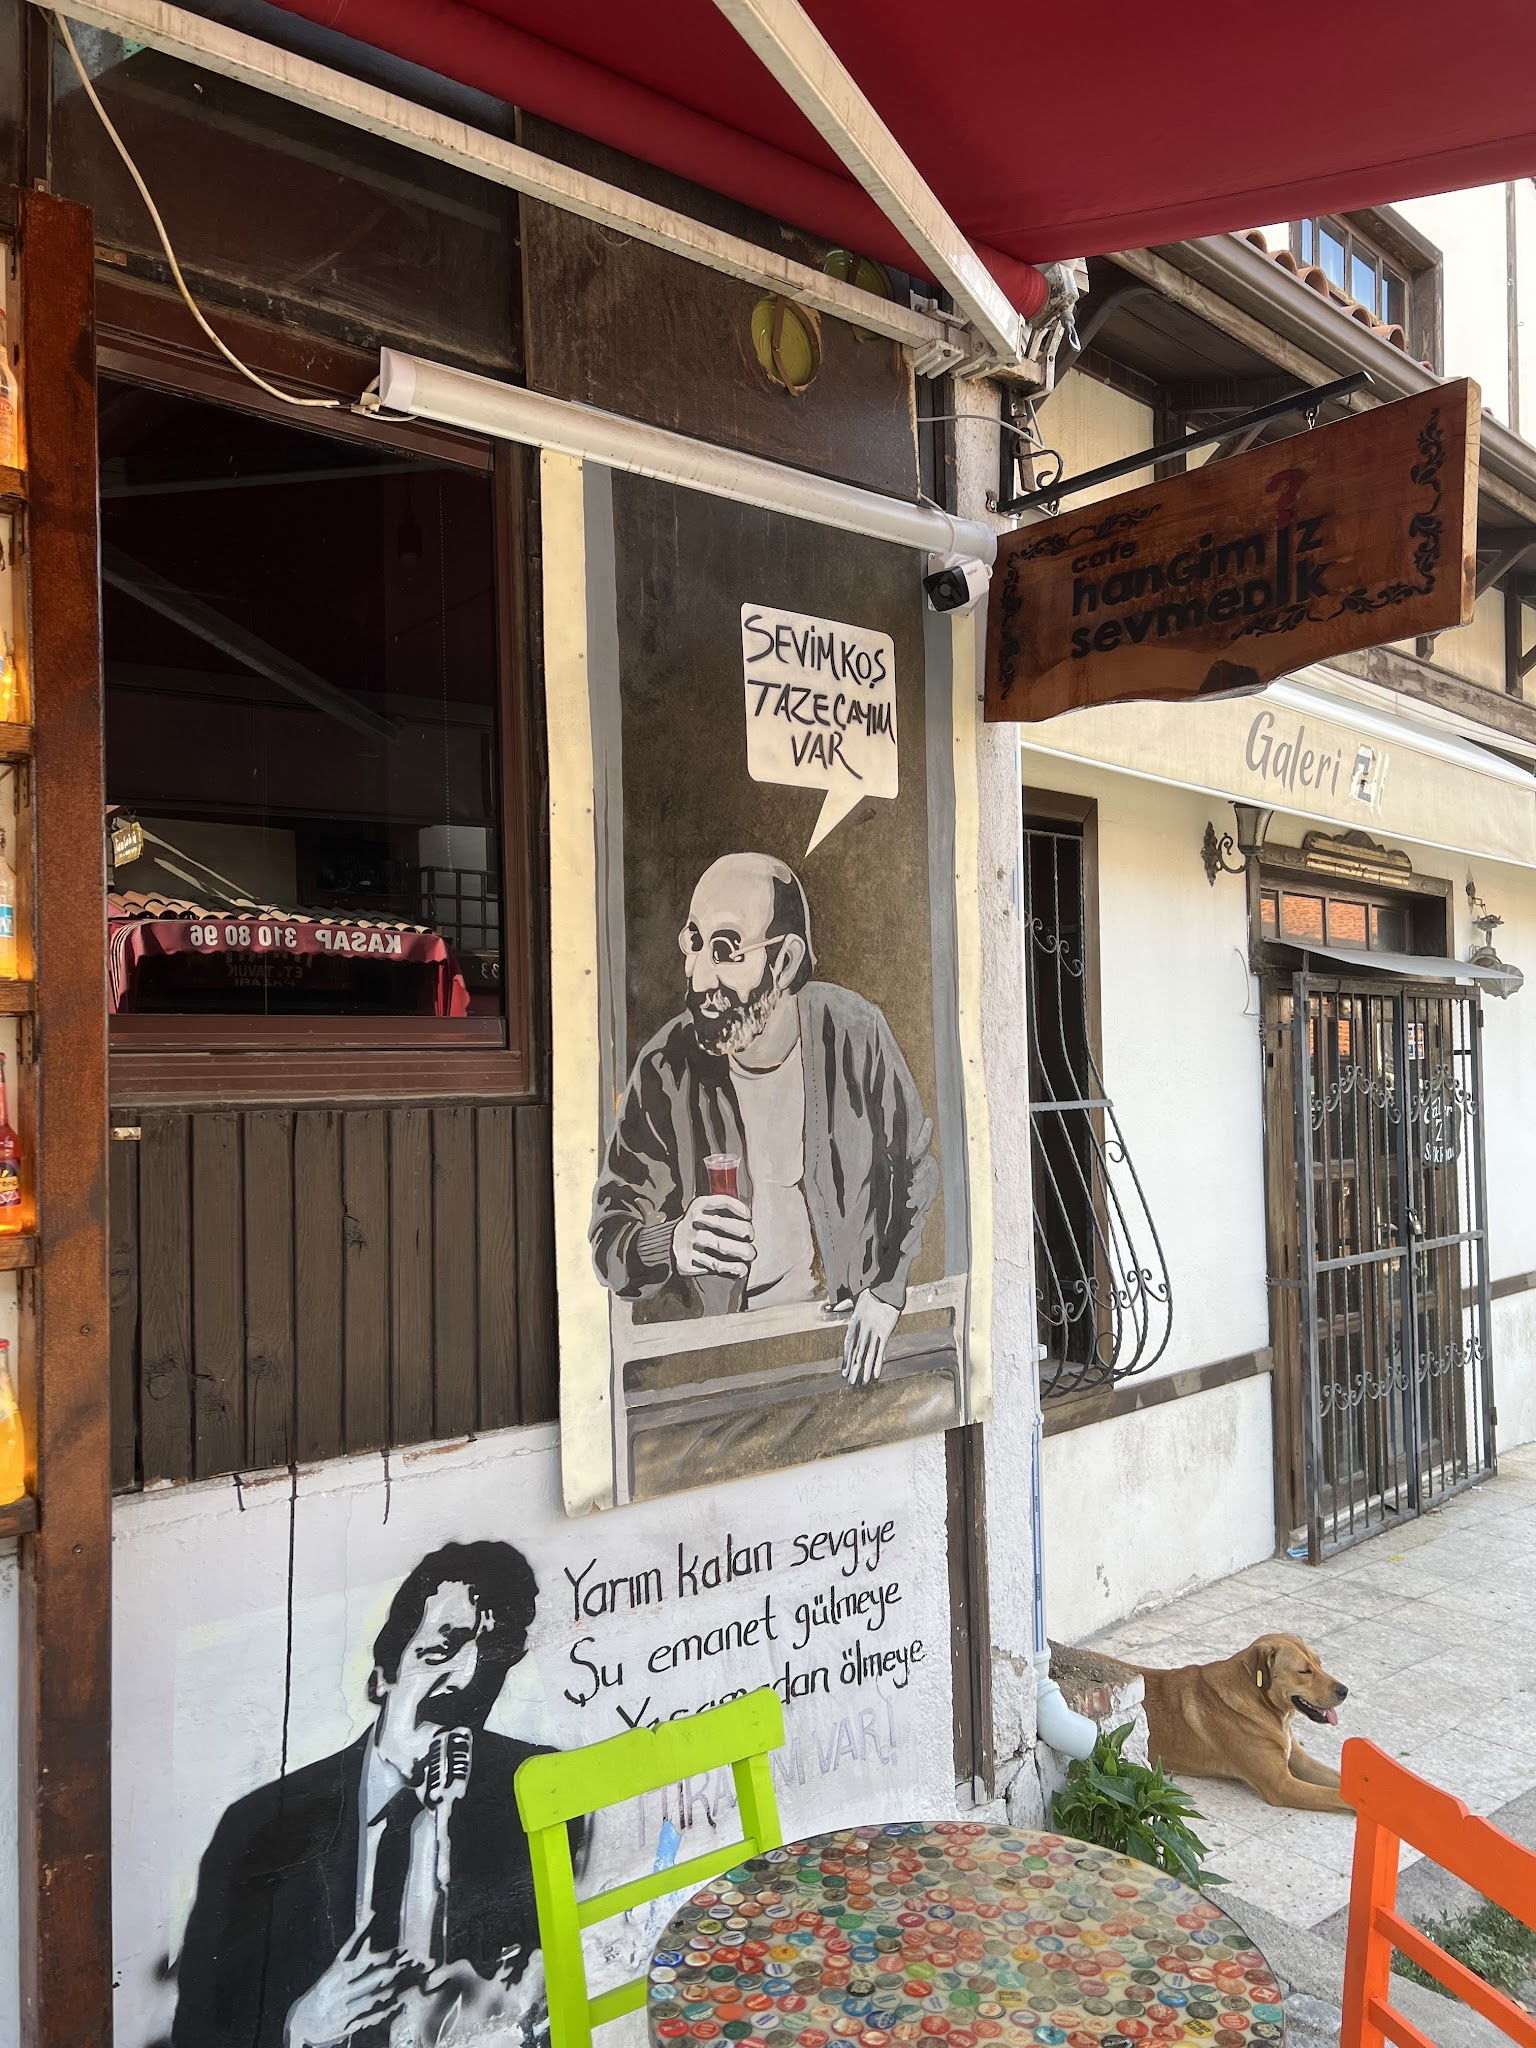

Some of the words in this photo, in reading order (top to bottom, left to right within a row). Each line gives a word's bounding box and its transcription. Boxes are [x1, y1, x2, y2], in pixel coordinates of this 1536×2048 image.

[1071, 541, 1138, 574] cafe
[790, 730, 863, 780] VAR
[1245, 710, 1342, 797] Galeri
[563, 1558, 663, 1621] Yarım
[677, 1533, 773, 1598] kalan
[790, 1520, 896, 1577] sevgiye
[564, 1636, 624, 1708] Şu
[647, 1595, 779, 1674] emanet
[792, 1581, 903, 1650] gülmeye
[840, 1638, 927, 1689] ölmeye
